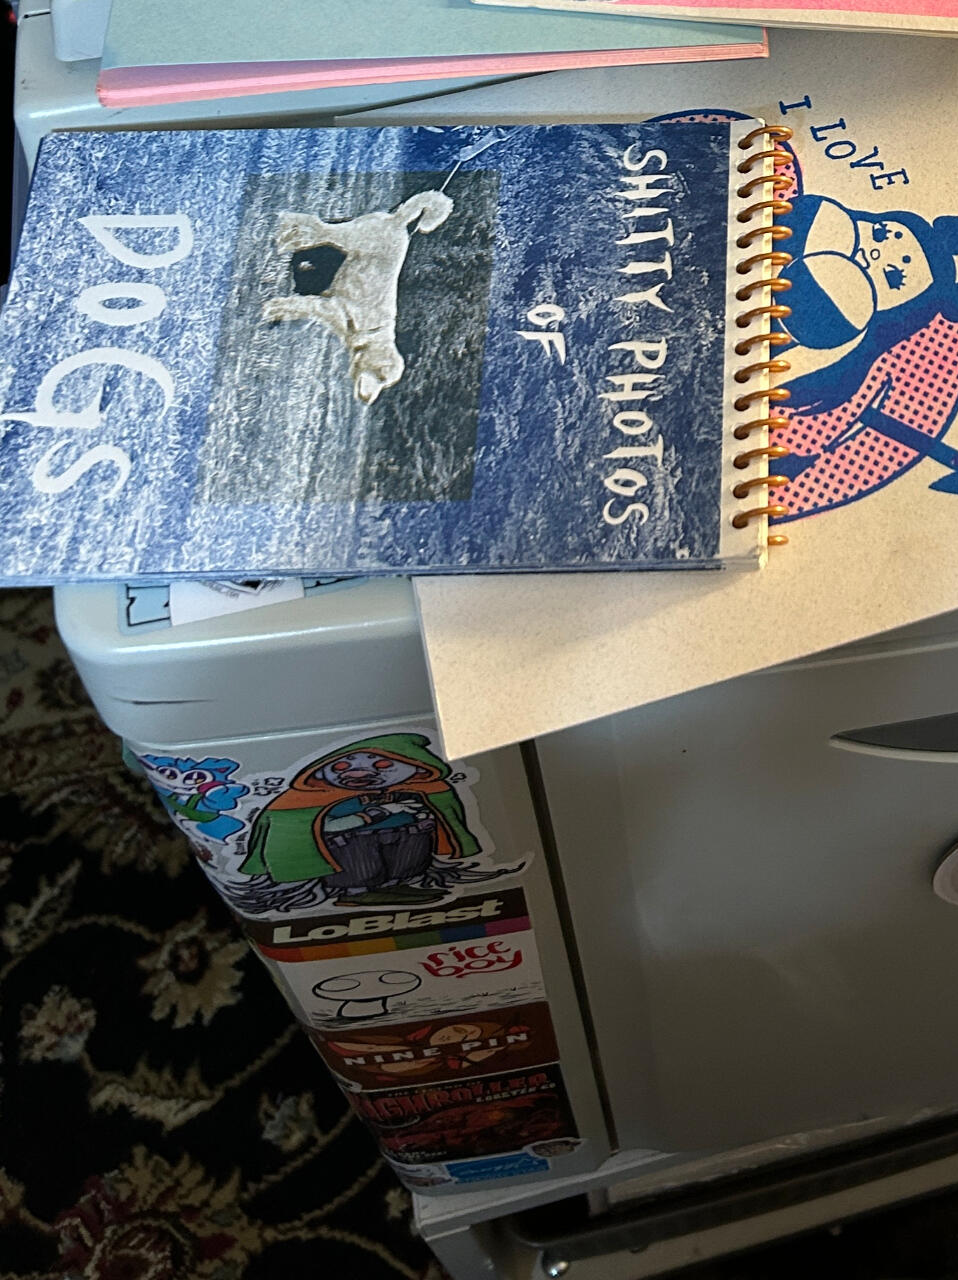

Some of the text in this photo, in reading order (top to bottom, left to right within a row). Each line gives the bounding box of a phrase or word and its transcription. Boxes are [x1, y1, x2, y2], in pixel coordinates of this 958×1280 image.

[810, 116, 911, 193] LOVE
[517, 302, 570, 368] OF
[597, 147, 676, 528] SHITTY PHOTOS
[272, 898, 504, 944] LoBlast
[420, 948, 523, 979] boy
[425, 939, 512, 968] rice
[343, 1032, 530, 1067] NINE PIN
